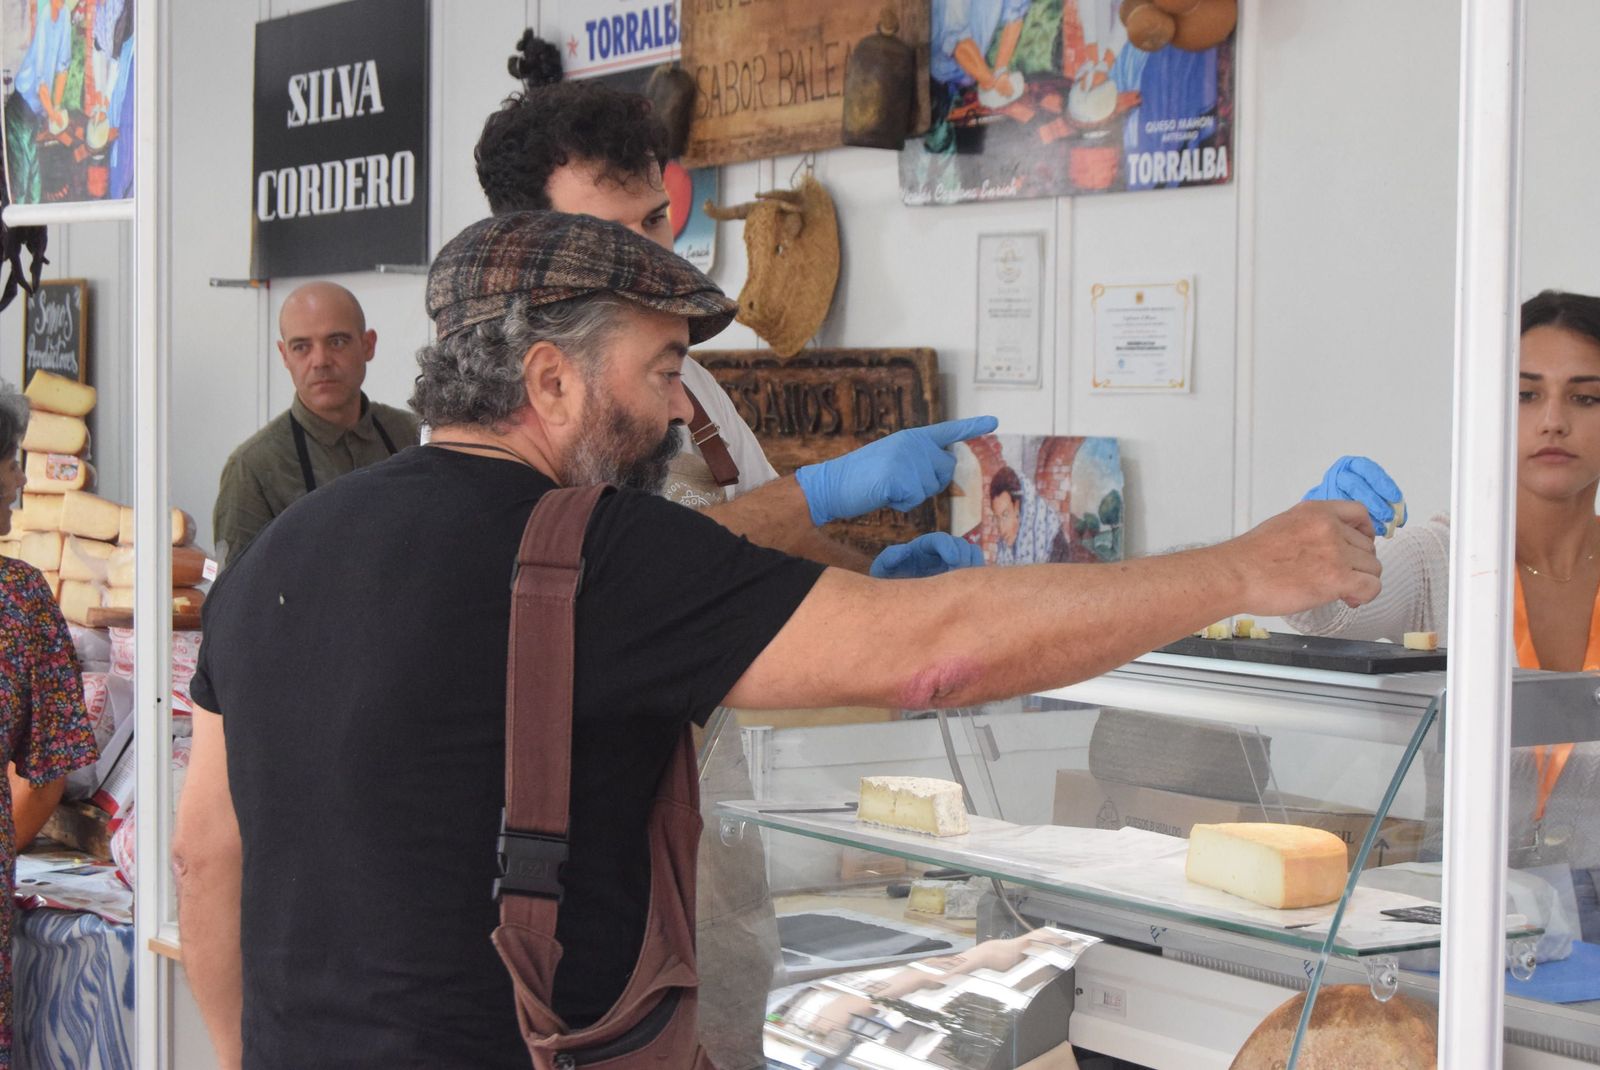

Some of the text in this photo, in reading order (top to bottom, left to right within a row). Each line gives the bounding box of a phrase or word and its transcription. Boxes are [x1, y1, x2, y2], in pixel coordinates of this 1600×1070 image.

[585, 2, 681, 61] TORRALB
[287, 59, 385, 129] SILVA
[695, 53, 769, 119] SABOR
[1145, 119, 1177, 134] QUESO
[257, 150, 415, 222] CORDERO
[1127, 145, 1228, 186] TORRALBA
